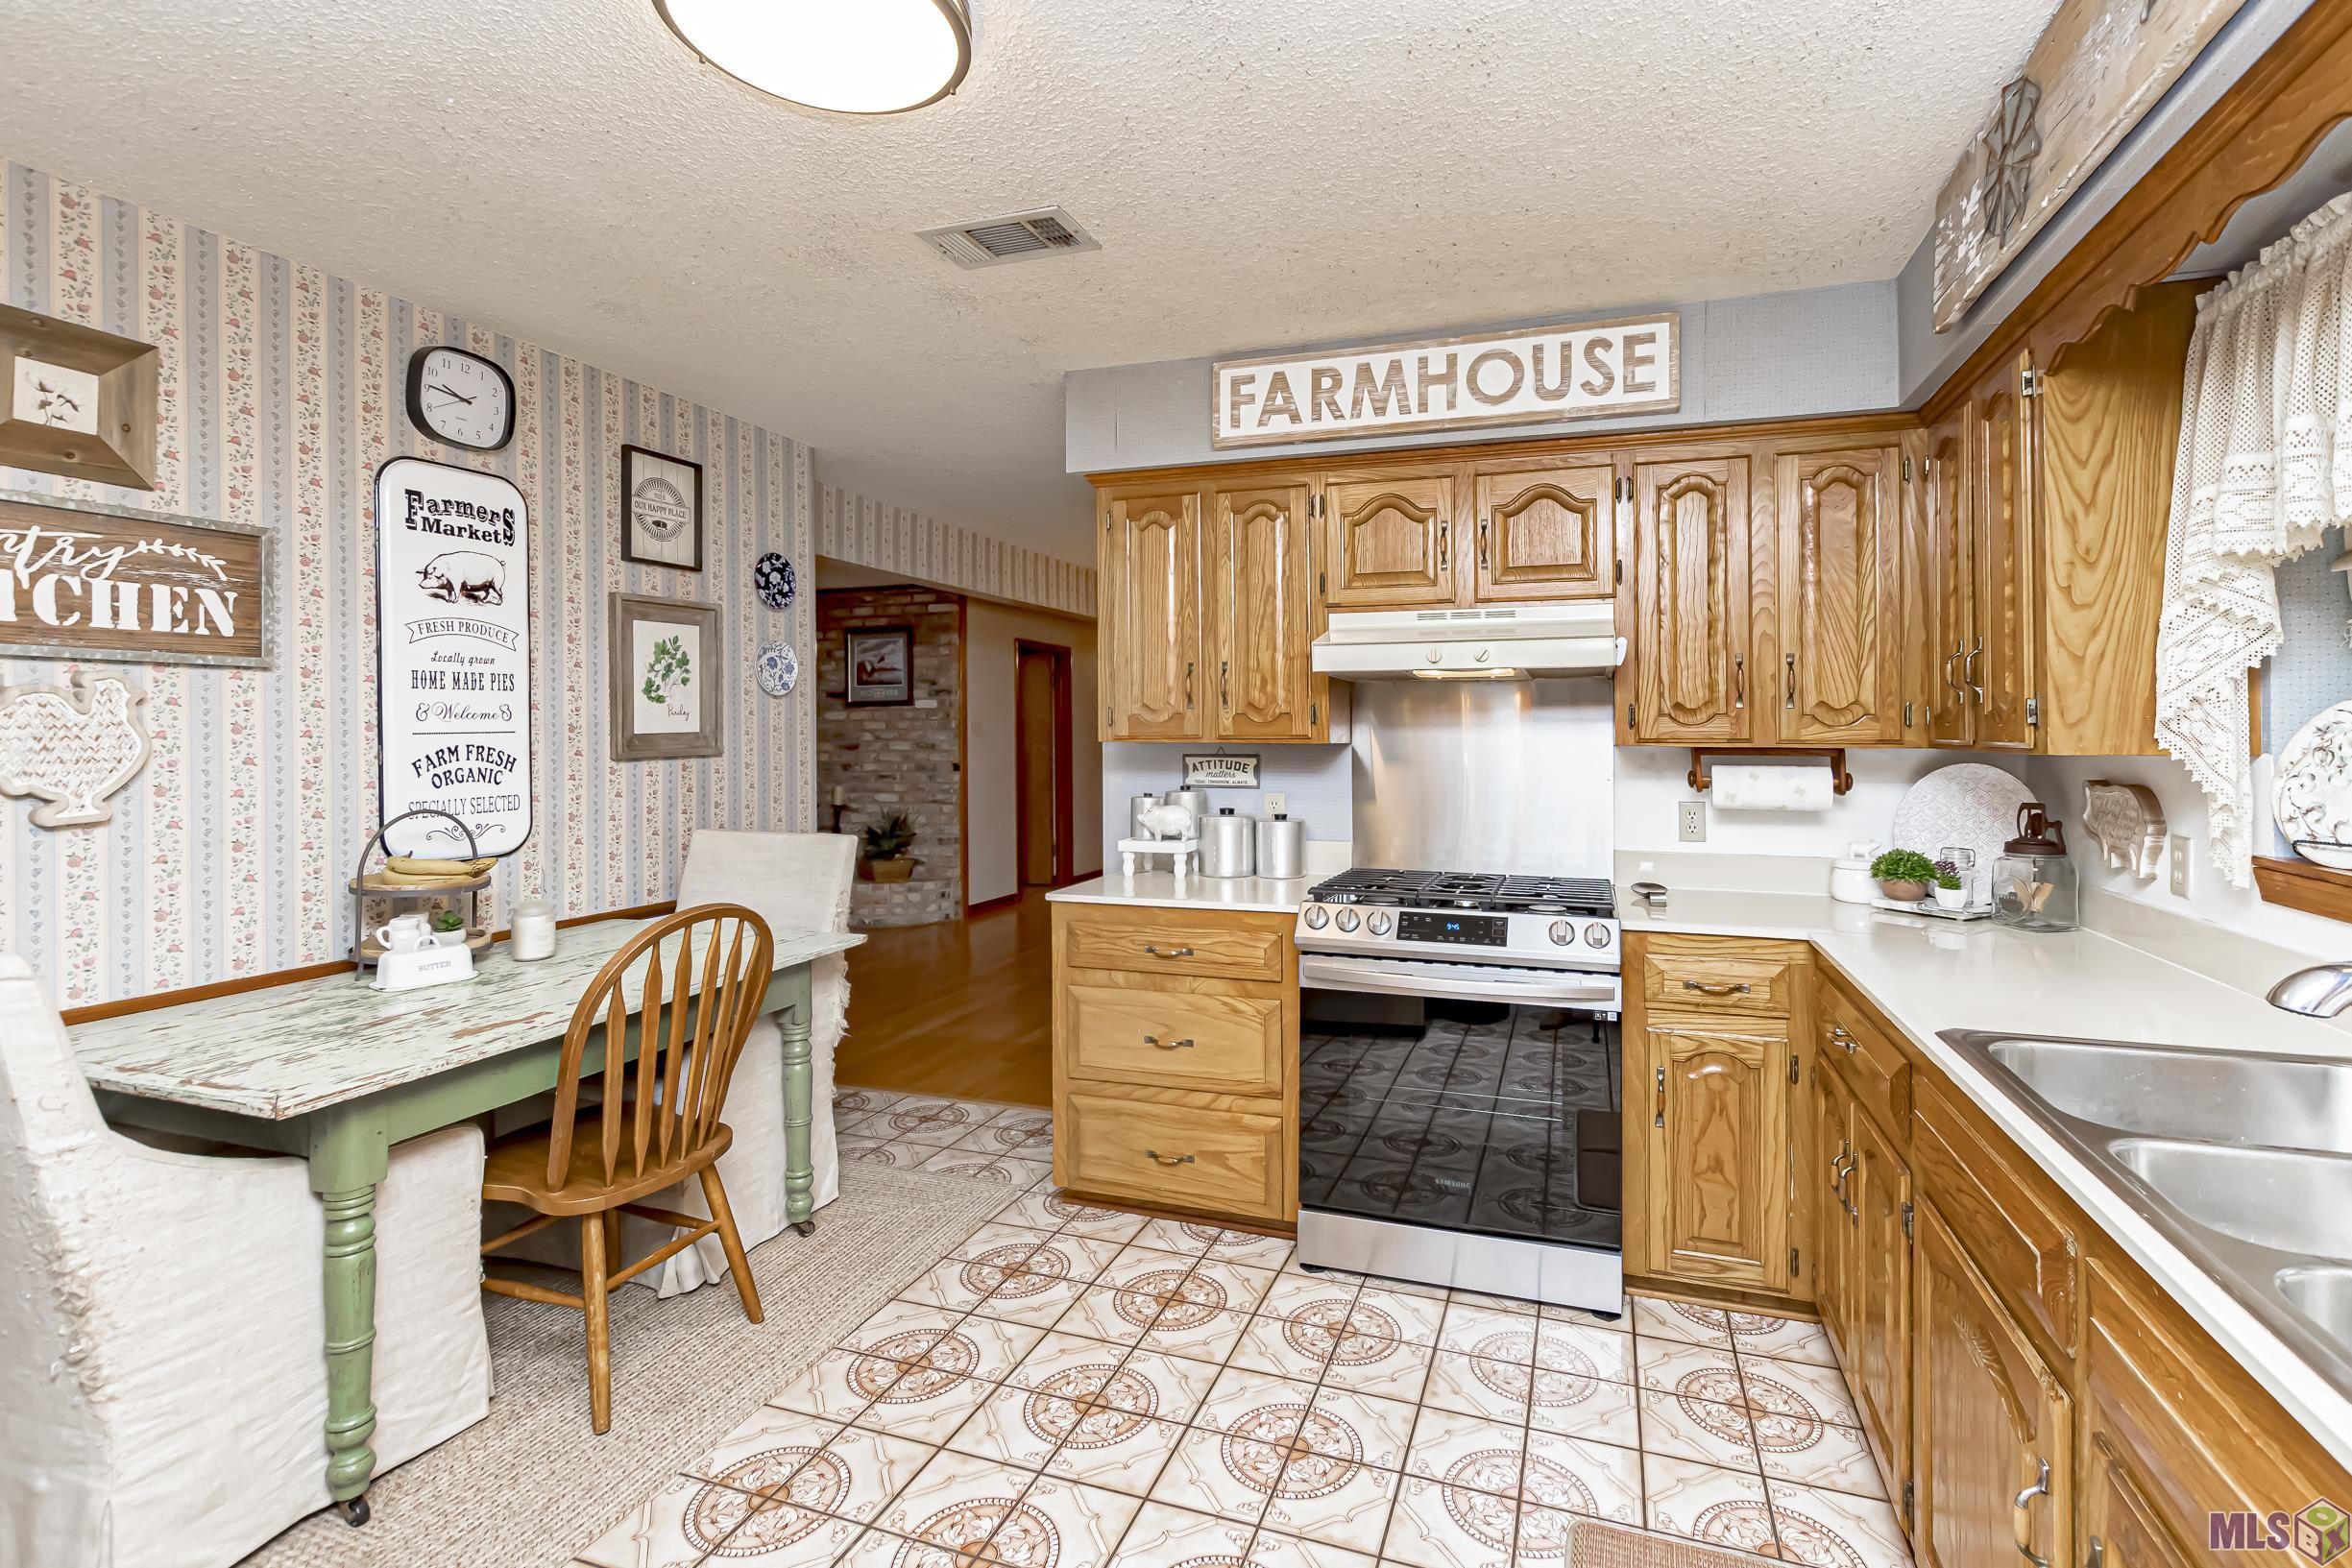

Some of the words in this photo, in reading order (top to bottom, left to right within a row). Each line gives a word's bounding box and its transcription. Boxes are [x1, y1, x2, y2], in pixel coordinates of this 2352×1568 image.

[442, 358, 450, 370] 11
[461, 362, 471, 374] 12
[427, 366, 438, 377] 10
[1229, 331, 1657, 429] FARMHOUSE
[424, 383, 430, 393] 9
[492, 387, 497, 398] 2
[425, 403, 432, 413] 8
[494, 406, 499, 416] 3
[440, 420, 446, 429] 7
[489, 422, 494, 432] 4
[457, 427, 464, 437] 6
[475, 430, 481, 441] 5
[647, 503, 667, 515] HAPPY
[667, 508, 687, 519] PLACE
[422, 516, 502, 544] Market
[417, 620, 454, 636] FRESH
[458, 620, 509, 644] PRODUCE
[430, 650, 466, 665] Locally
[468, 655, 496, 667] grown
[411, 669, 446, 690] HOME
[451, 671, 485, 691] MADE
[490, 673, 516, 692] PIES
[431, 701, 498, 723] Welcome
[411, 744, 460, 779] FARM
[465, 743, 518, 774] FRESH
[1192, 759, 1250, 774] ATTITUDE
[430, 766, 504, 790] ORGANIC
[1205, 769, 1237, 779] matters
[408, 798, 467, 820] SPECIALLY
[470, 794, 521, 815] SELECTED
[418, 960, 451, 973] BUTTER
[1435, 1177, 1471, 1189] SAMSUNG
